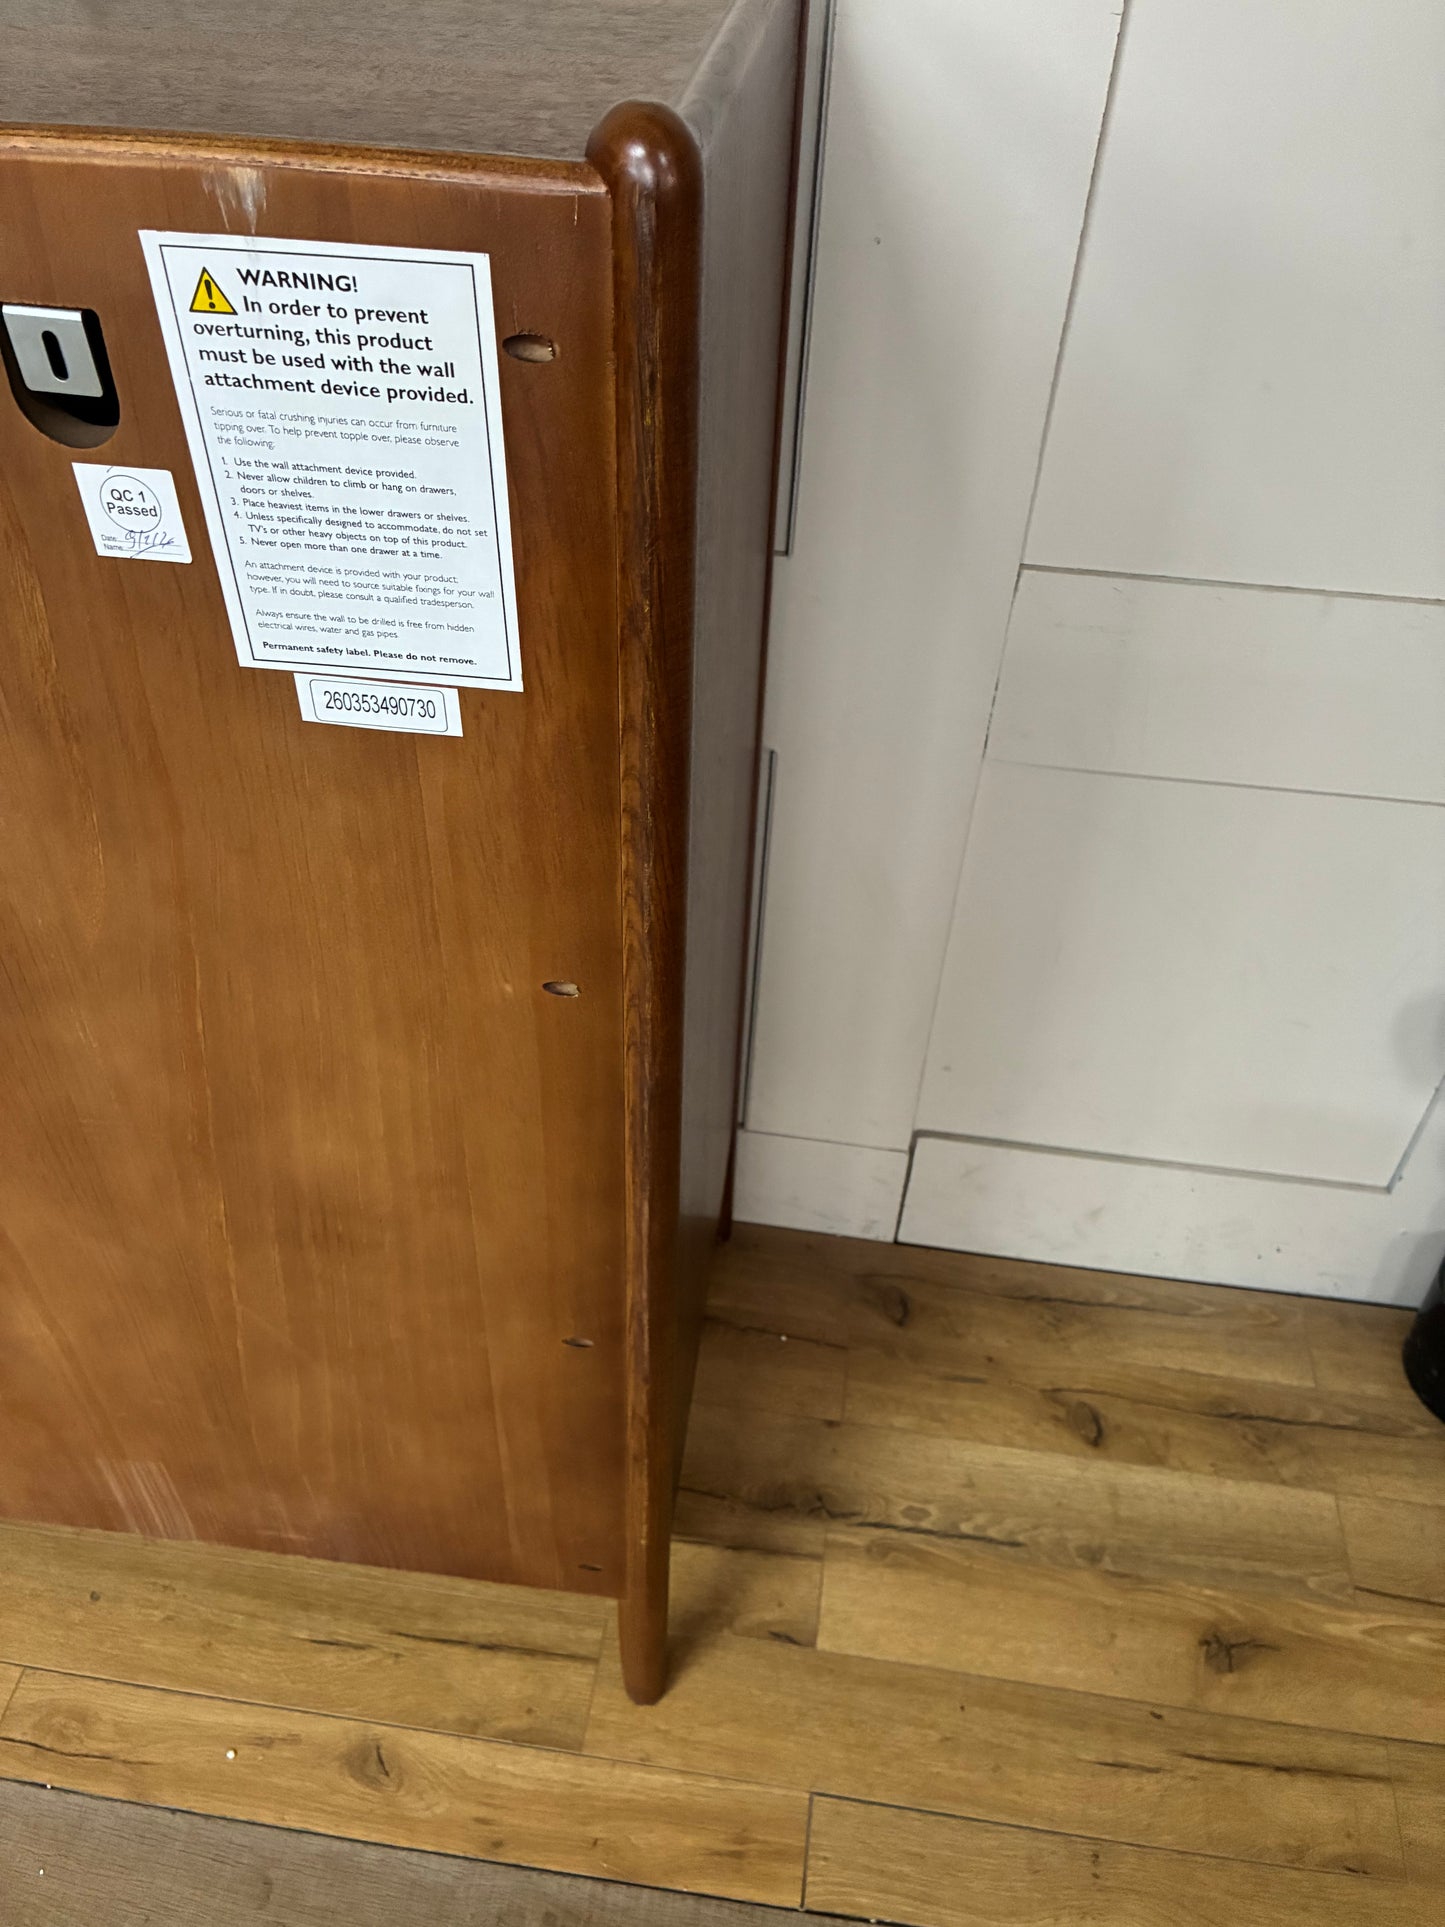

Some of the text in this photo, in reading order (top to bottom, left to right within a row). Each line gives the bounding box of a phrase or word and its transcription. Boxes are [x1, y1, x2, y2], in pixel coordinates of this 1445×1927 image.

[235, 267, 358, 293] WARNING!
[242, 295, 429, 324] In order to prevent
[193, 323, 433, 351] overturning, this product
[198, 348, 455, 378] must be used with the wall
[204, 372, 474, 404] attachment device provided.
[209, 405, 457, 433] Serious or fatal crushing injuries can occur from furniture
[213, 422, 245, 434] tipping
[267, 424, 281, 435] To
[282, 425, 302, 438] help
[304, 429, 338, 439] prevent
[339, 431, 369, 442] topple
[370, 434, 392, 443] over,
[394, 434, 422, 445] please
[424, 436, 460, 448] observe
[216, 434, 232, 445] the
[233, 457, 252, 467] Use
[253, 458, 269, 469] the
[270, 461, 289, 470] wall
[291, 463, 342, 474] attachment
[344, 465, 373, 476] device
[375, 469, 417, 479] provided.
[110, 488, 147, 503] QC 1
[236, 470, 264, 481] Never
[266, 473, 291, 483] allow
[292, 475, 328, 486] children
[329, 479, 341, 487] to
[342, 479, 367, 489] climb
[381, 481, 403, 494] hang
[419, 484, 457, 496] drawers,
[239, 484, 314, 499] doors or shelves.
[106, 501, 158, 517] Passed
[230, 496, 239, 506] 3.
[242, 497, 265, 508] Place
[266, 500, 303, 511] heaviest
[305, 503, 330, 513] items
[331, 505, 340, 513] in
[342, 505, 357, 515] the
[359, 506, 384, 517] lower
[387, 509, 422, 519] drawers
[436, 512, 470, 523] shelves.
[233, 510, 488, 537] 4. Unless specifically designed to accommodate, do not set
[247, 523, 268, 534] TV's
[281, 527, 306, 536] other
[307, 528, 333, 541] heavy
[335, 531, 367, 542] objects
[382, 535, 399, 545] top
[401, 535, 410, 544] of
[412, 536, 429, 546] this
[431, 538, 467, 548] product.
[239, 535, 247, 545] 5.
[250, 537, 277, 547] Never
[279, 541, 302, 550] open
[303, 543, 327, 551] more
[328, 542, 349, 552] than
[350, 546, 368, 554] one
[369, 545, 399, 556] drawer
[401, 549, 411, 557] at
[419, 550, 443, 559] time.
[244, 559, 258, 568] An
[259, 562, 305, 572] attachment
[306, 564, 333, 574] device
[343, 568, 380, 578] provided
[381, 570, 401, 579] with
[402, 573, 422, 581] your
[246, 571, 495, 598] however, you will need to source suitable fixings for your wall
[249, 585, 270, 594] type.
[271, 585, 277, 594] If
[289, 587, 316, 597] doubt,
[317, 589, 343, 599] please
[345, 593, 374, 602] consult
[383, 595, 418, 605] qualified
[419, 598, 474, 609] tradesperson.
[255, 608, 475, 633] Always ensure the wall to be drilled is free from hidden
[257, 620, 293, 630] electrical
[294, 625, 318, 633] wires,
[318, 626, 342, 634] water
[344, 627, 360, 636] and
[361, 629, 375, 638] gas
[262, 640, 314, 652] Permanent
[316, 645, 343, 656] safety
[345, 647, 371, 657] label.
[373, 649, 403, 659] Please
[405, 652, 418, 660] do
[439, 656, 477, 665] remove.
[323, 690, 436, 719] 260353490730
